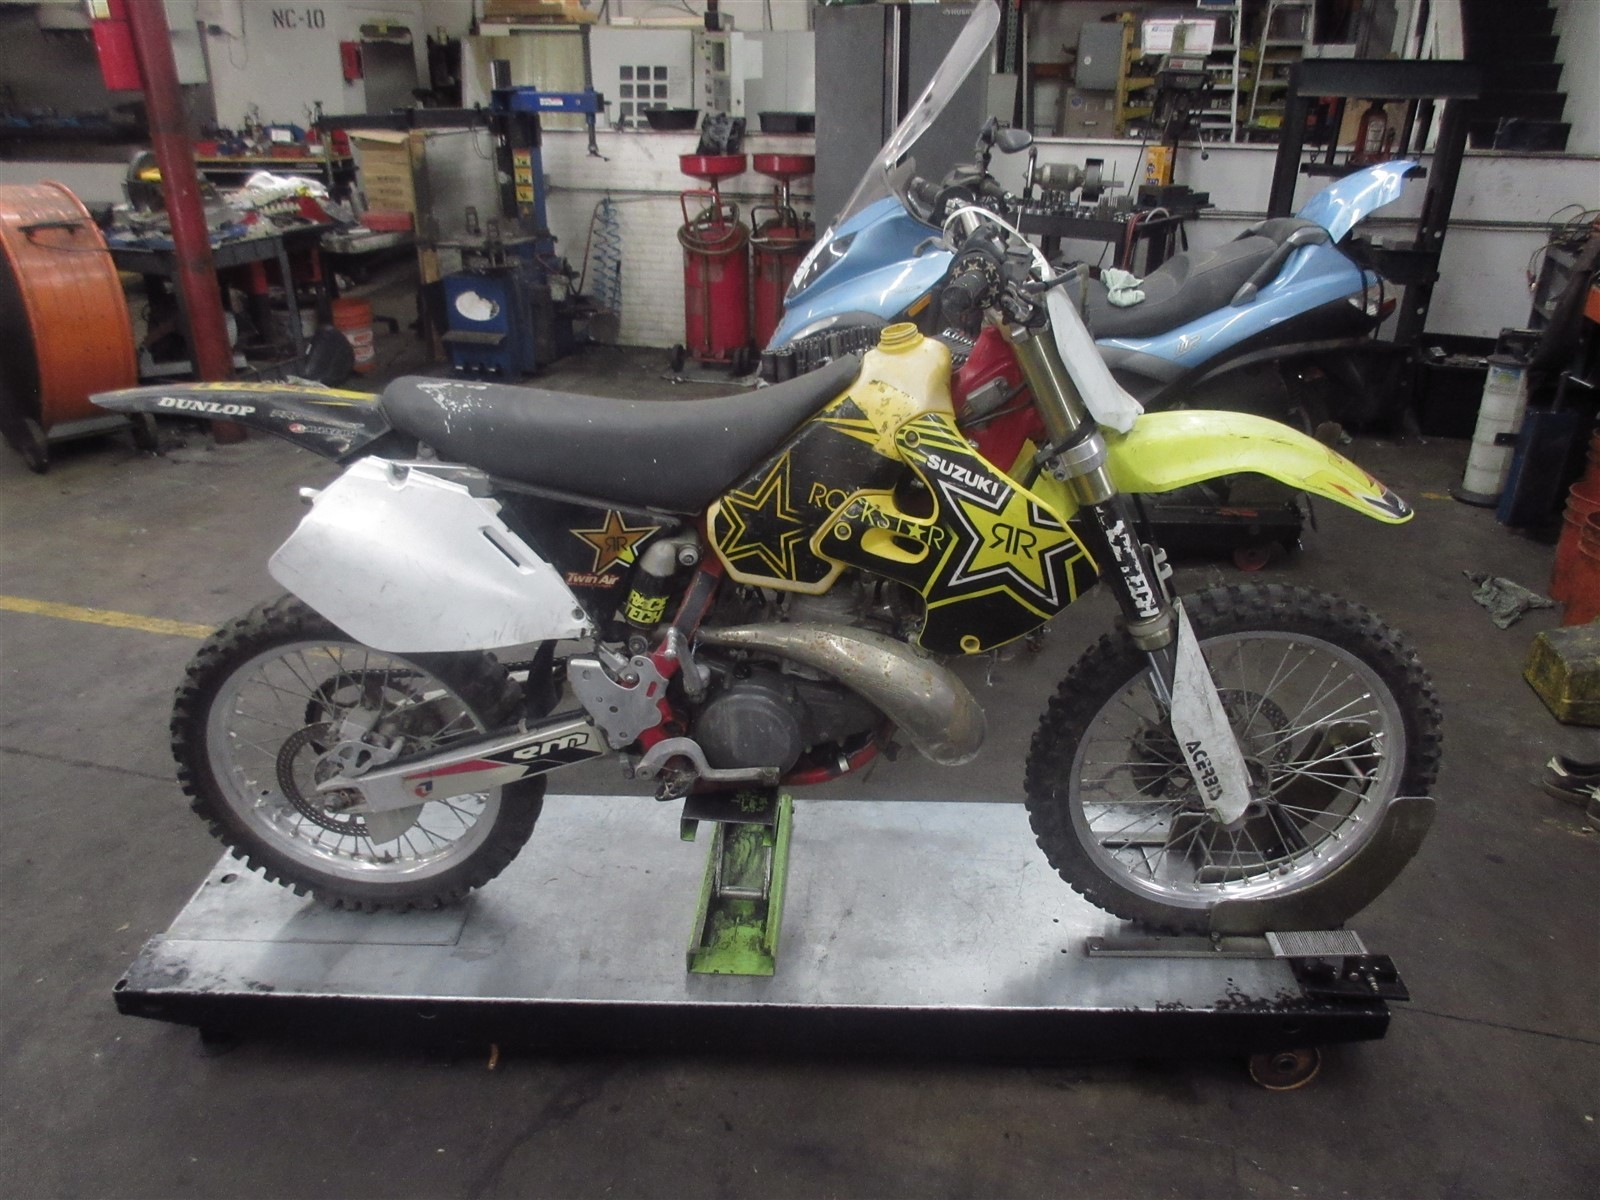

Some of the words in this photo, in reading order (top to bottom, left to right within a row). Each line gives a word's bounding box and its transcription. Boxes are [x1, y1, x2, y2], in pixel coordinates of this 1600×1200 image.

[271, 8, 325, 29] NC-10
[157, 396, 256, 416] DUNLOP
[926, 453, 999, 497] SUZUKI
[566, 571, 599, 584] Twin
[598, 574, 620, 585] Air
